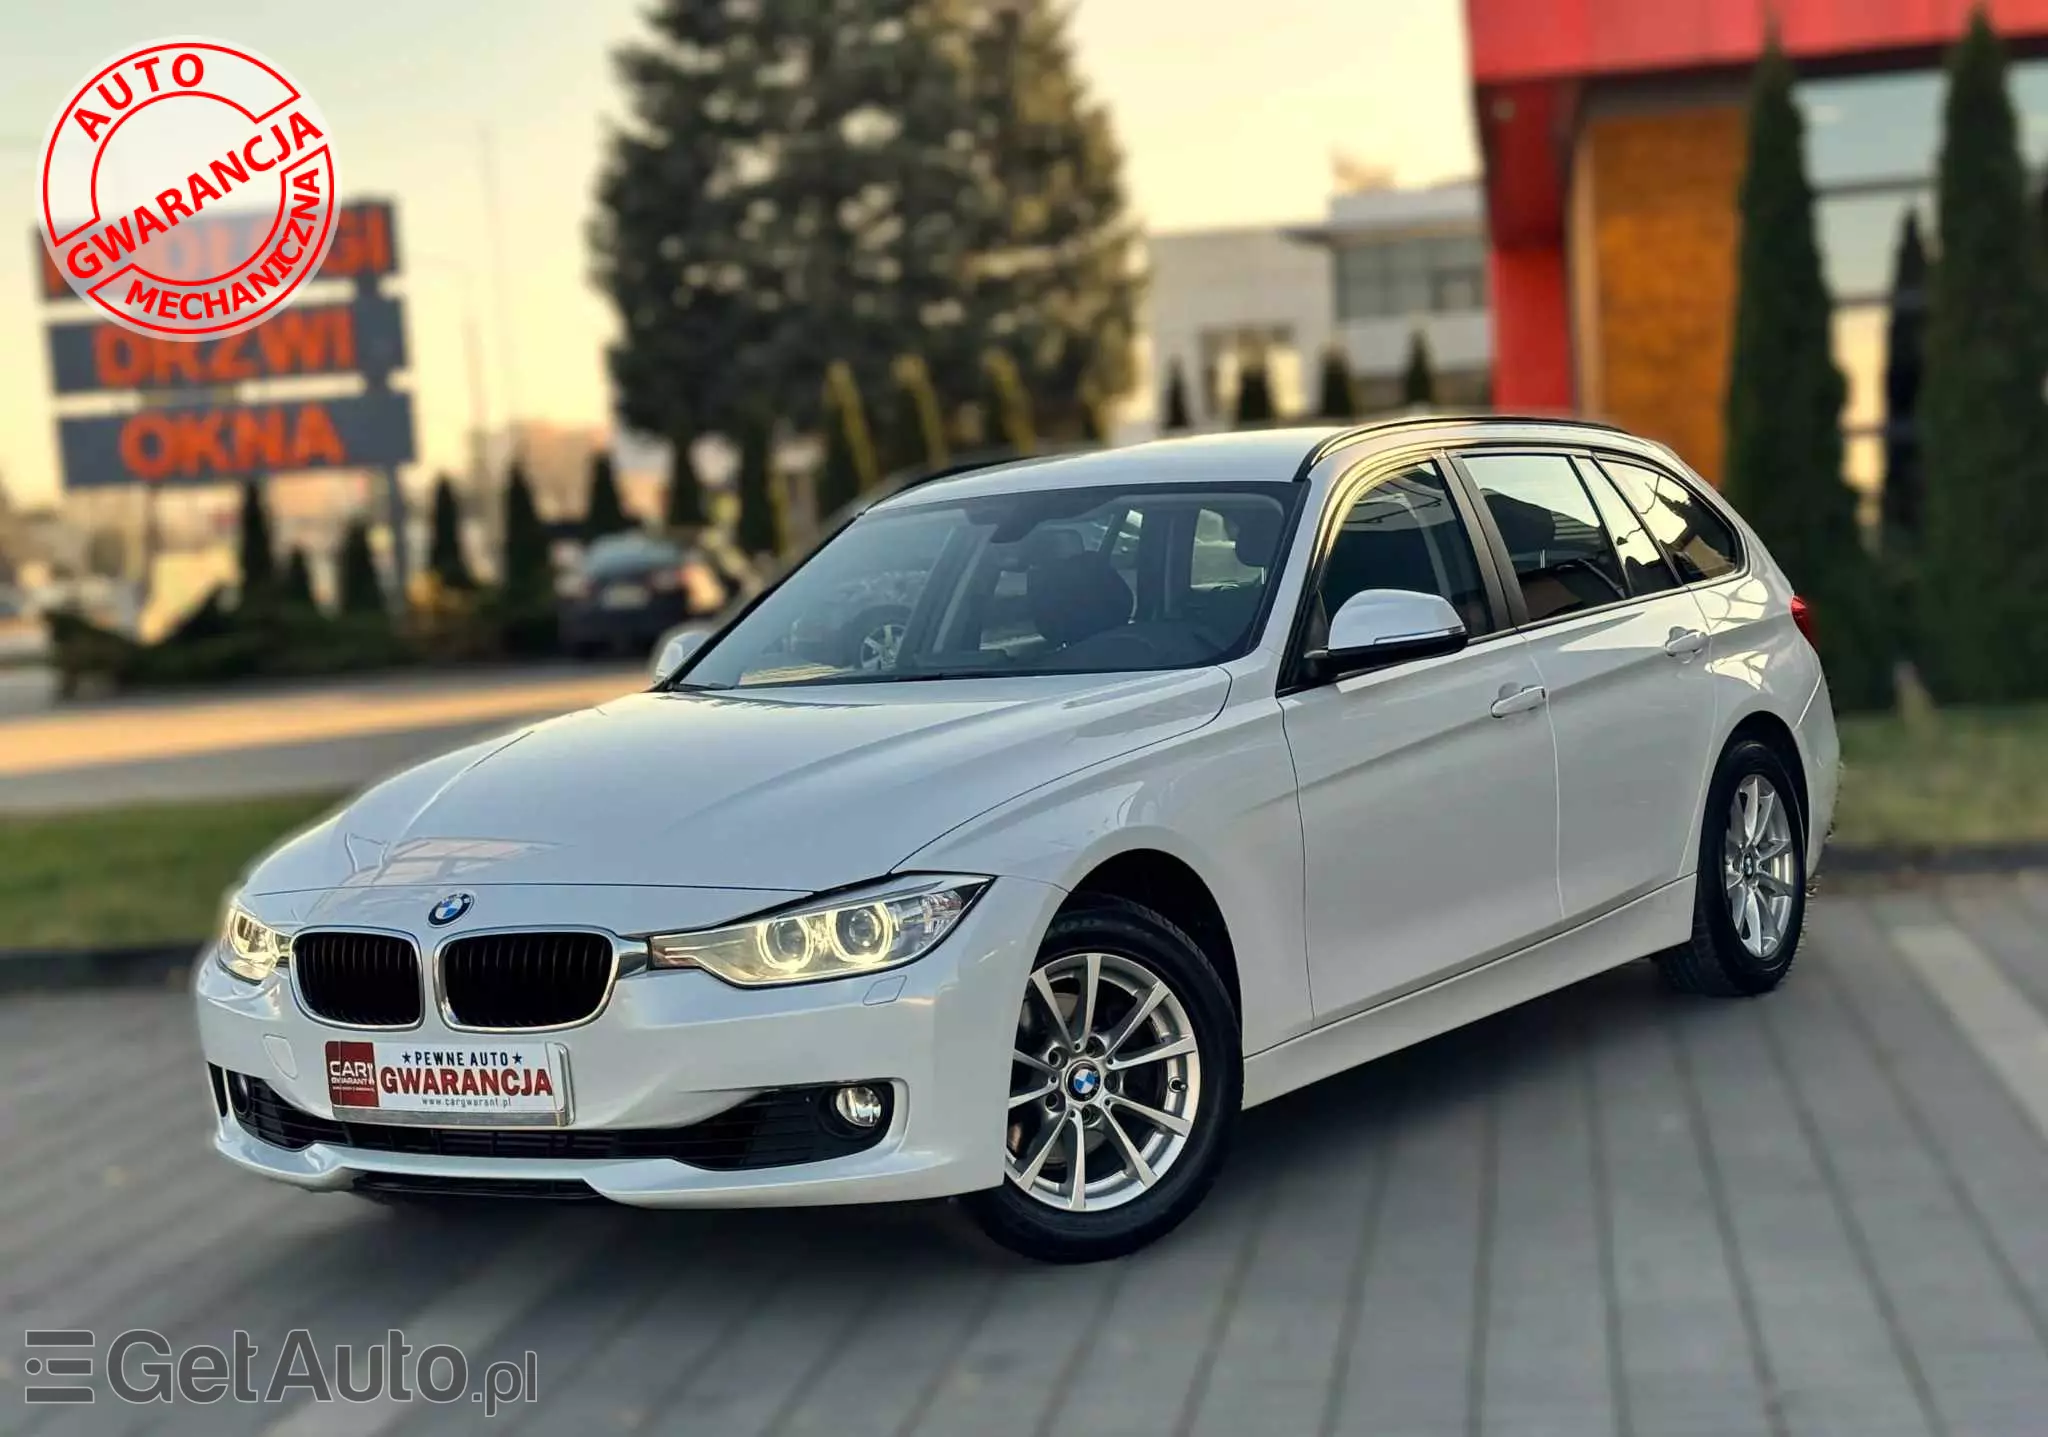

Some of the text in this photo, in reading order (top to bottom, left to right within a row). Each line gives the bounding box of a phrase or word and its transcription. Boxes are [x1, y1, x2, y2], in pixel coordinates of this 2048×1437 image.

[94, 309, 357, 386] DRZWI
[119, 402, 346, 479] OKNA
[416, 1051, 509, 1067] PEWNE AUTO
[380, 1066, 553, 1096] GWARANCJA
[422, 1097, 512, 1108] www.cargwarant.pl
